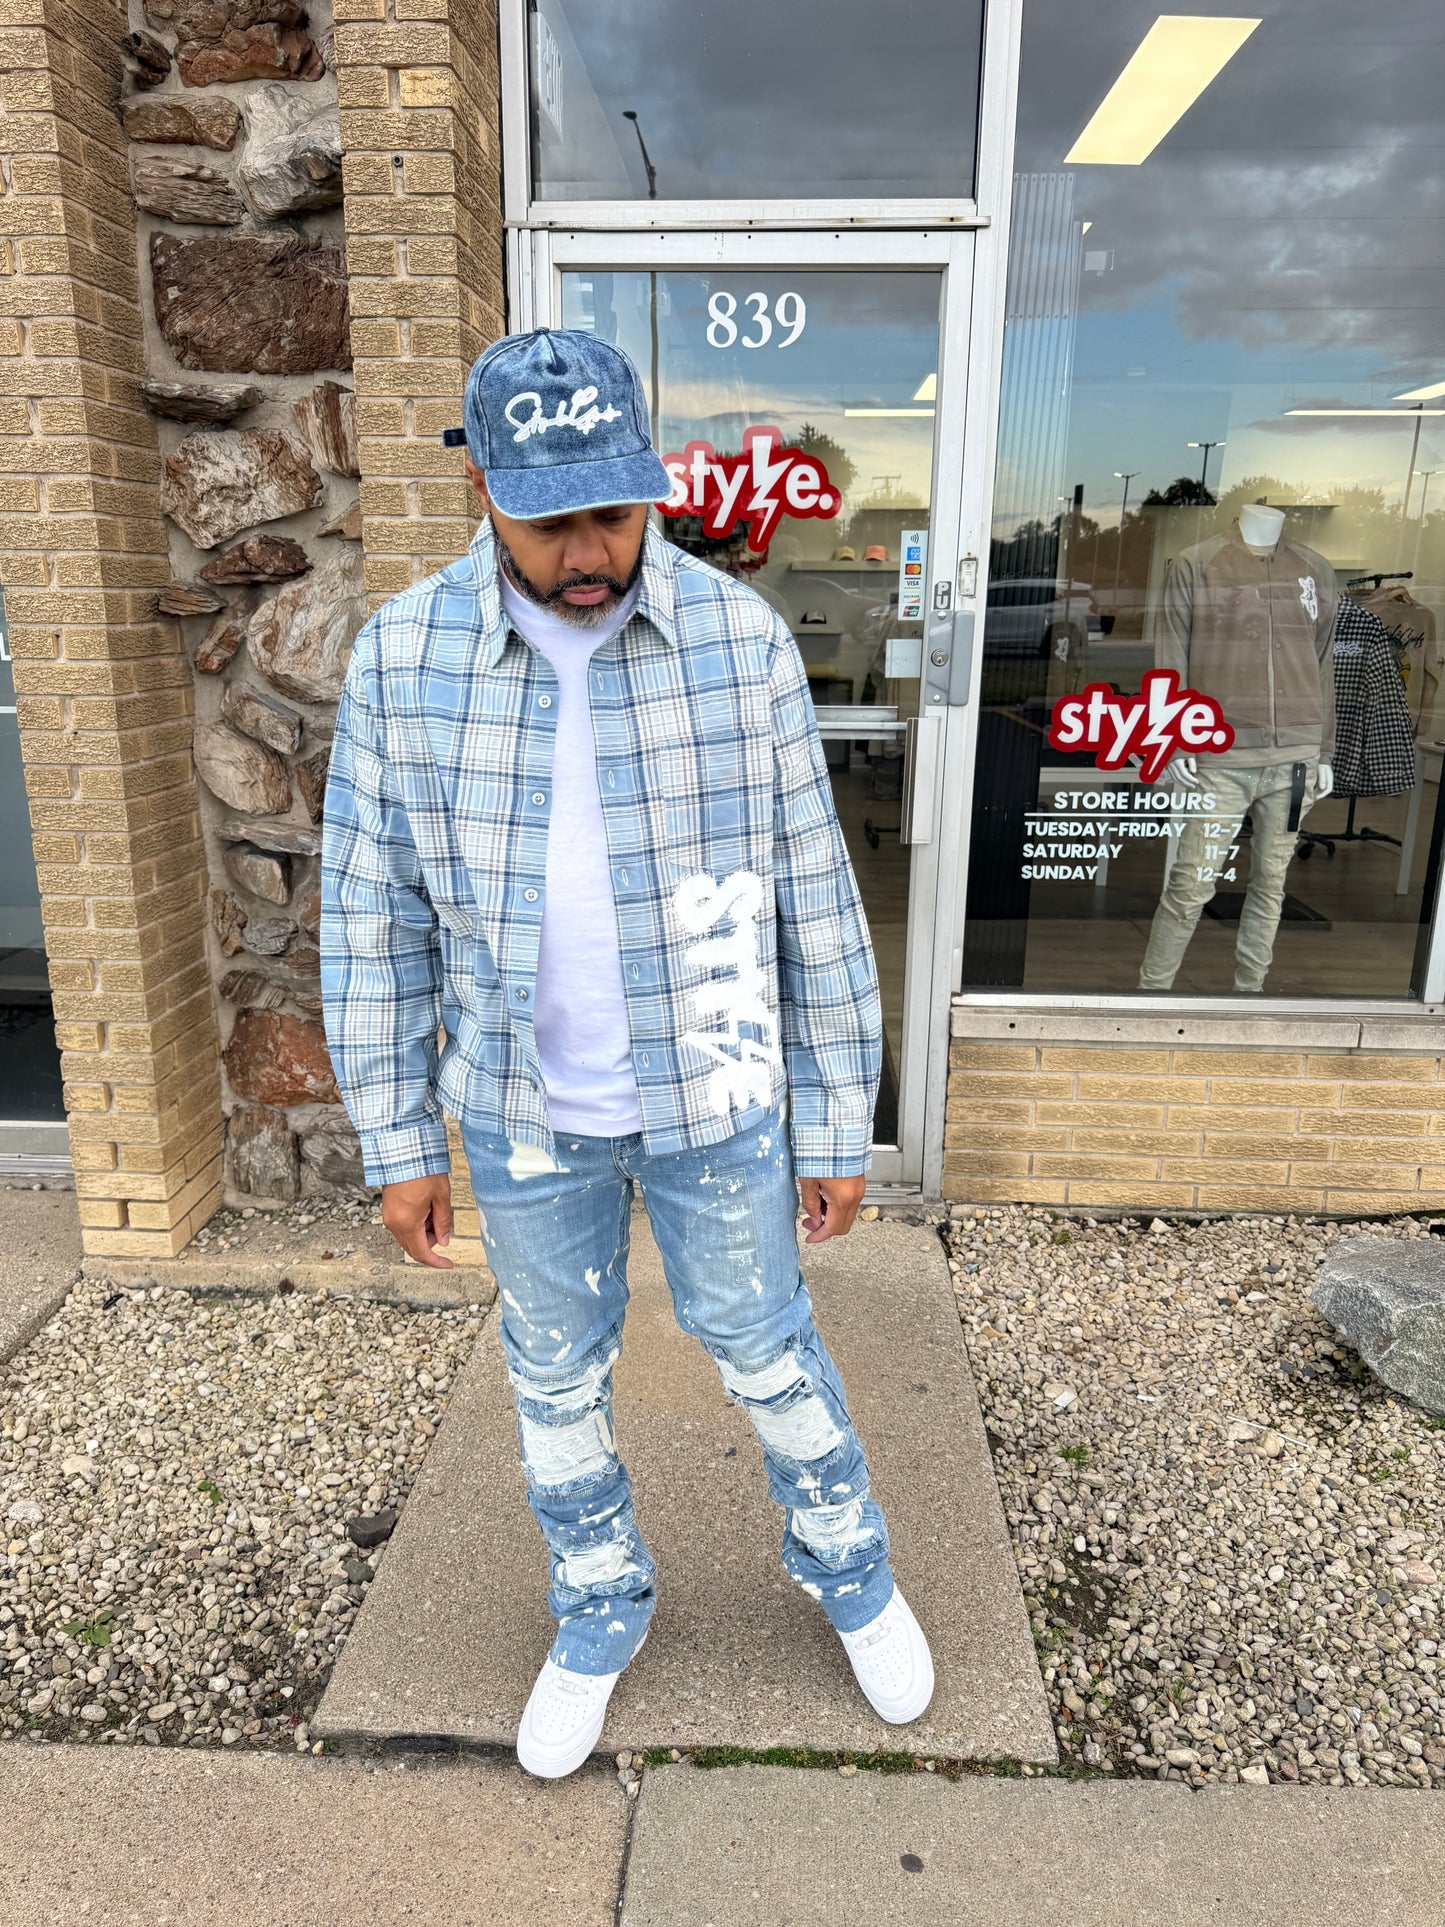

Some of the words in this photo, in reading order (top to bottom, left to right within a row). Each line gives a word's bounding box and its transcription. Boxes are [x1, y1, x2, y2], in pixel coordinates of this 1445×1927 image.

[706, 291, 806, 348] 839
[1054, 791, 1129, 810] STORE
[1134, 791, 1217, 810] HOURS
[1025, 821, 1187, 838] TUESDAY-FRIDAY
[1203, 822, 1243, 839] 12-7
[1022, 843, 1123, 859] SATURDAY
[1204, 845, 1240, 861] 11-7
[1021, 865, 1098, 880] SUNDAY
[1196, 867, 1237, 882] 12-4
[735, 1229, 750, 1242] 34
[738, 1254, 753, 1267] 34
